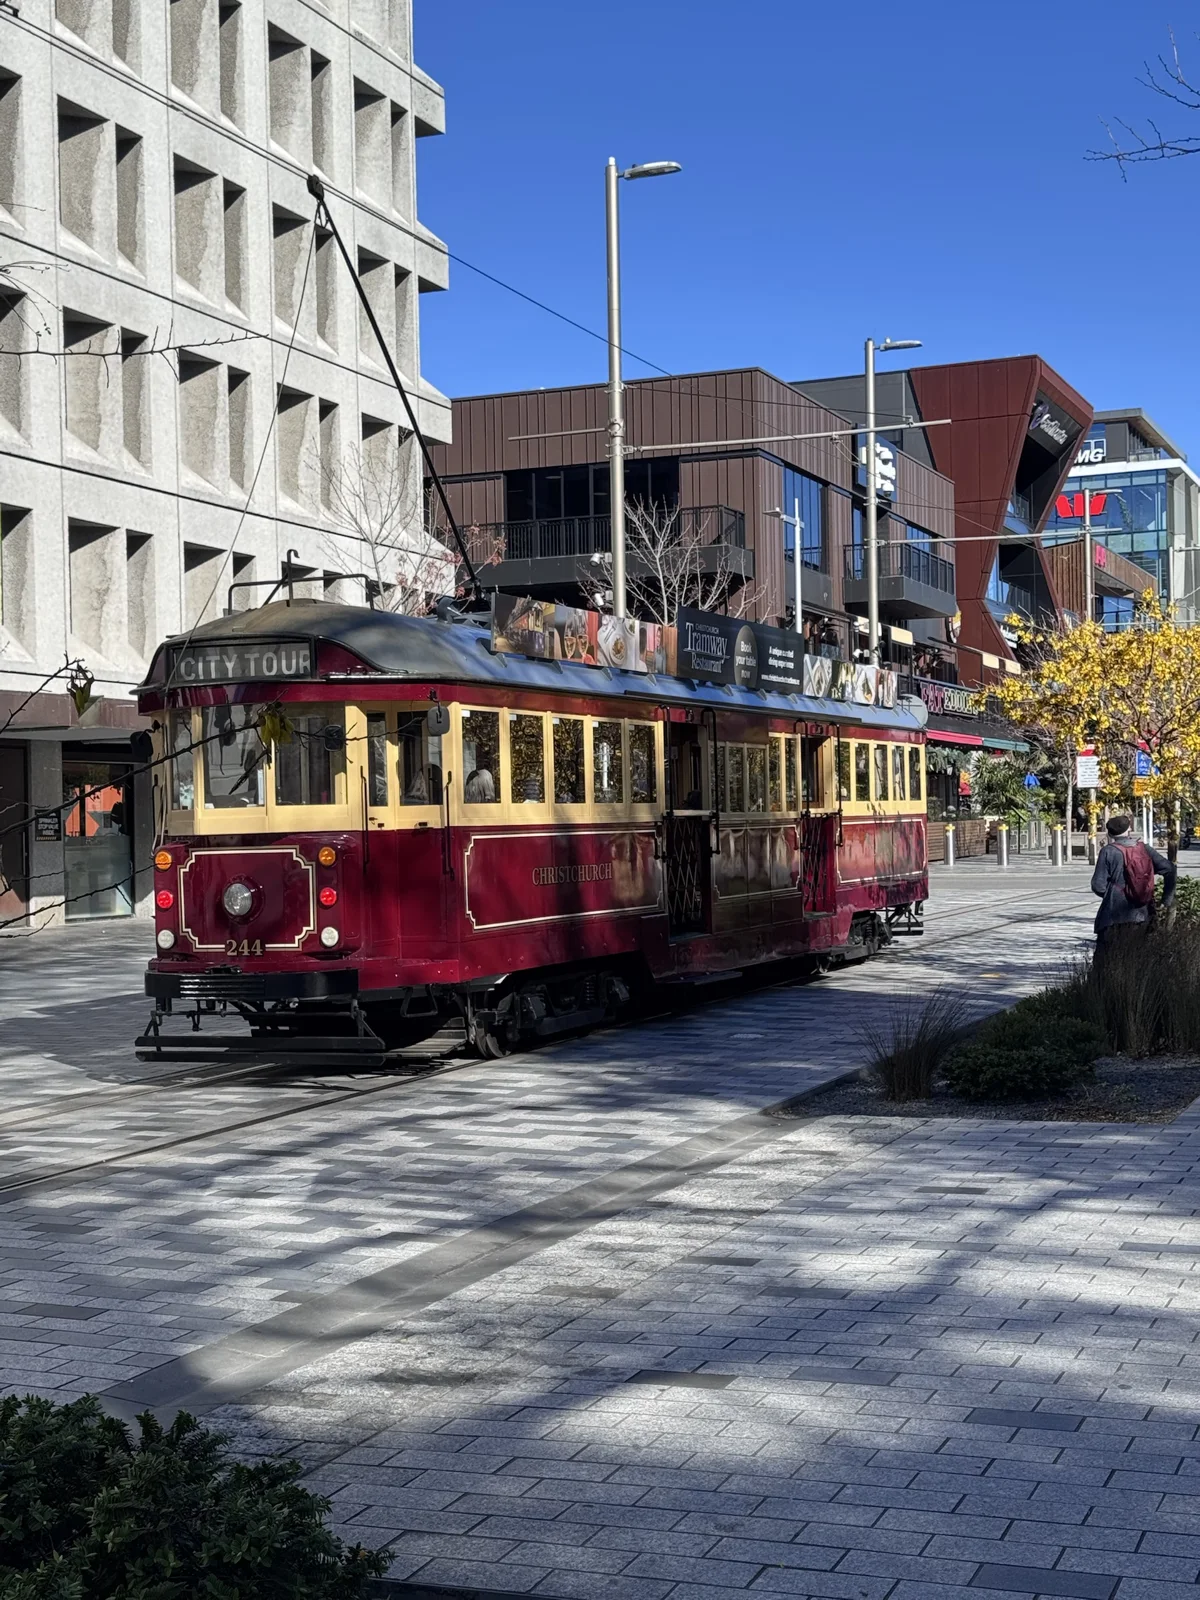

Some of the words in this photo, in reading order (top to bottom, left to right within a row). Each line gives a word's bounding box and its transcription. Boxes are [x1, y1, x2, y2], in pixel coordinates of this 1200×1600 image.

[685, 622, 728, 664] Tramway
[740, 641, 753, 653] Book
[180, 654, 237, 681] CITY
[244, 650, 311, 677] TOUR
[691, 652, 722, 673] Restaurant
[735, 655, 746, 667] your
[745, 656, 757, 667] table
[741, 669, 751, 678] now
[920, 681, 944, 714] FAT
[532, 862, 613, 886] CHRISTCHURCH
[226, 939, 264, 956] 244
